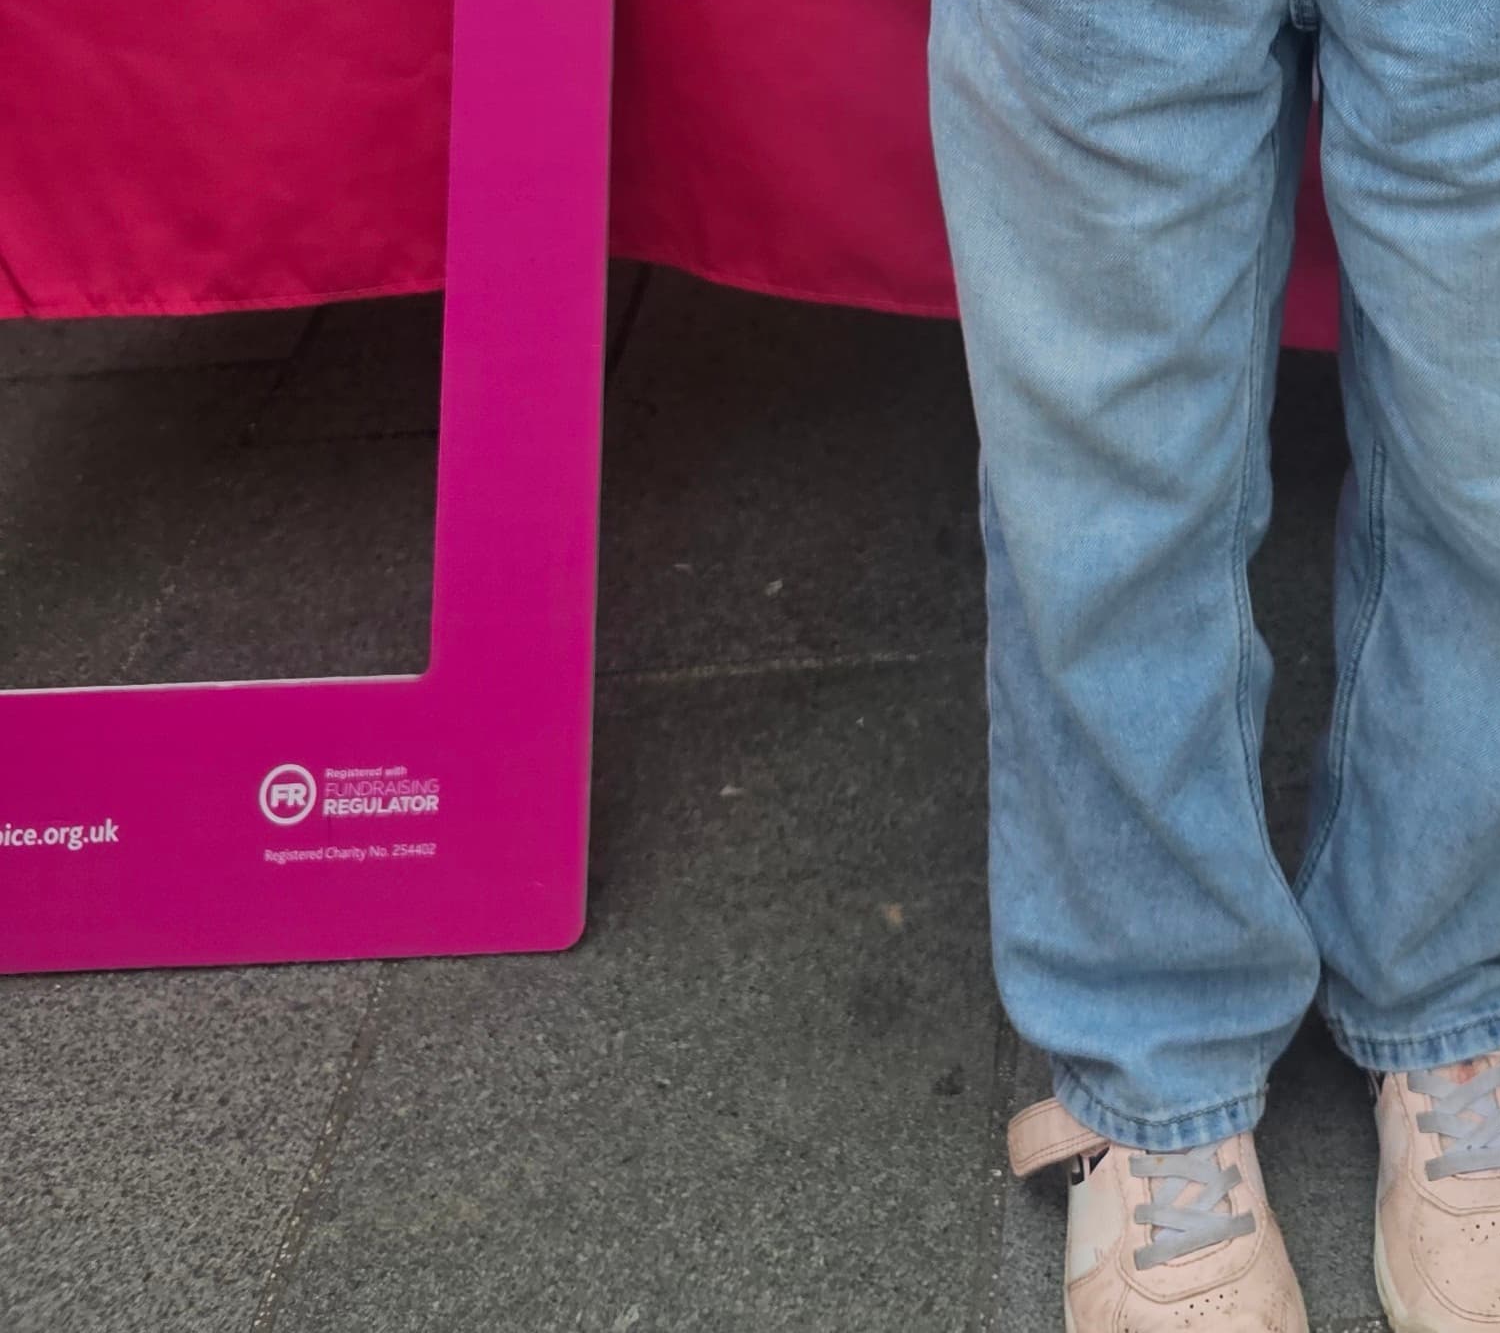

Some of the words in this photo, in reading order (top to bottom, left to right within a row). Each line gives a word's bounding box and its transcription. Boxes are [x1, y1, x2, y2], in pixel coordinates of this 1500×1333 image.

[325, 779, 440, 798] FUNDRAISING
[323, 794, 439, 816] REGULATOR
[264, 847, 323, 865] Registered
[326, 846, 367, 862] Charity
